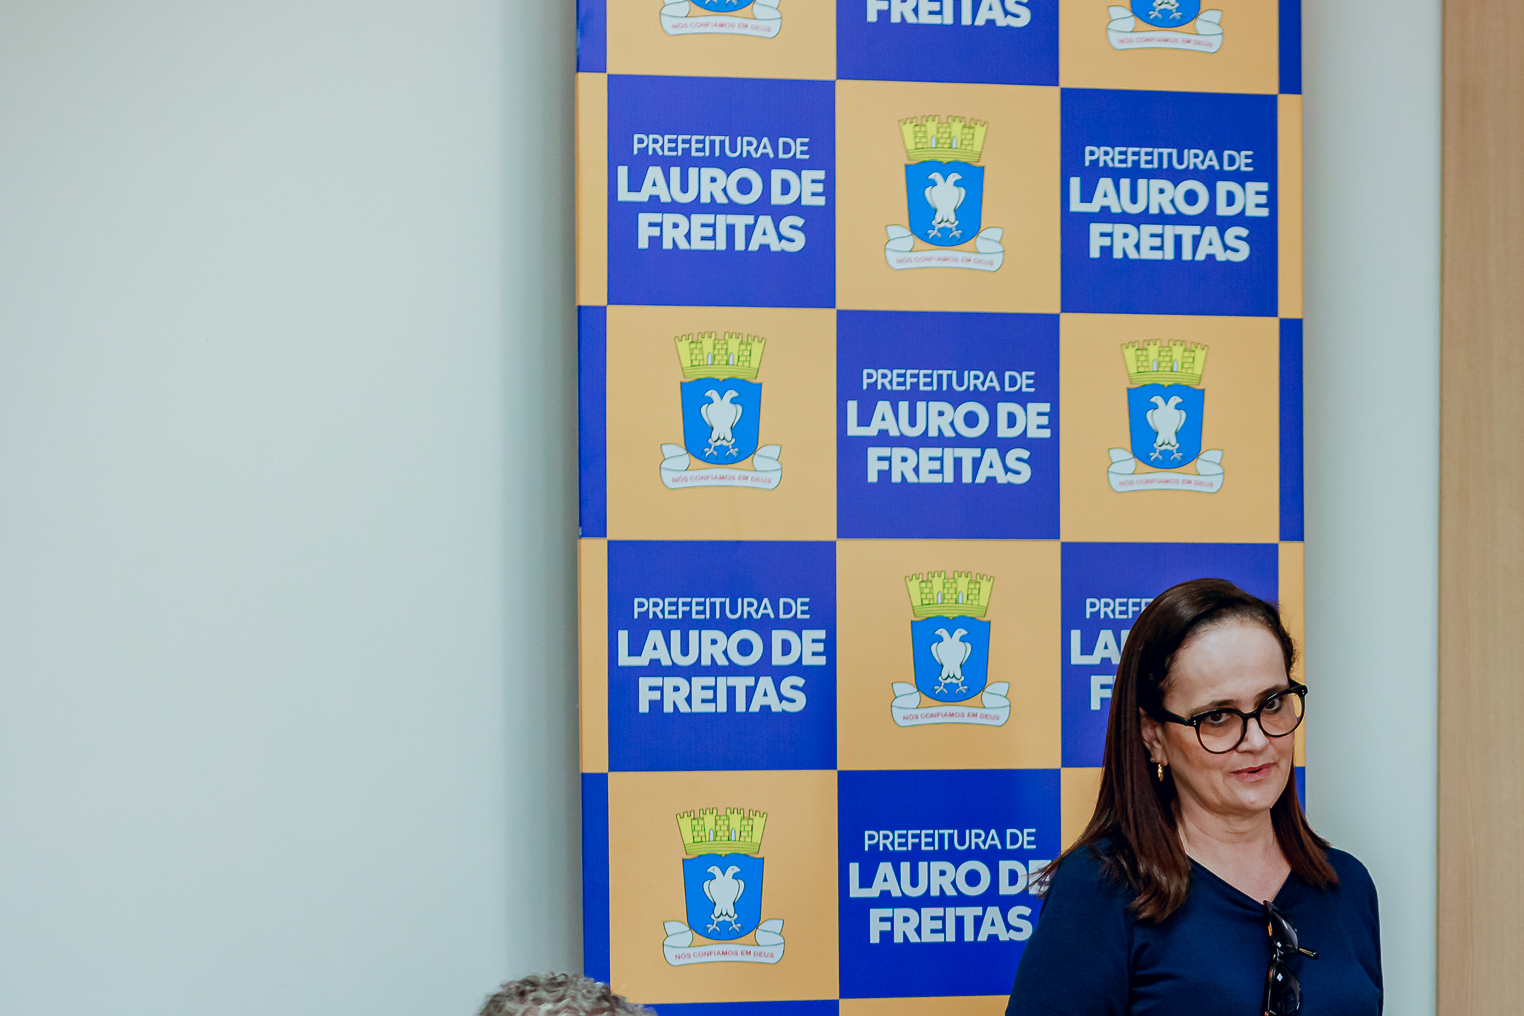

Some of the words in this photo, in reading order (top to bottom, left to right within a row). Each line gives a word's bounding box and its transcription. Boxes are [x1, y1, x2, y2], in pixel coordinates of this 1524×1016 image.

[867, 0, 1031, 27] FREITAS
[634, 134, 774, 158] PREFEITURA
[779, 138, 809, 159] DE
[1085, 146, 1219, 169] PREFEITURA
[1224, 151, 1253, 171] DE
[618, 166, 762, 204] LAURO
[771, 169, 825, 205] DE
[1070, 177, 1209, 215] LAURO
[1216, 181, 1269, 216] DE
[638, 213, 805, 252] FREITAS
[1090, 223, 1249, 261] FREITAS
[863, 369, 1000, 391] PREFEITURA
[1005, 371, 1035, 392] DE
[847, 400, 989, 437] LAURO
[997, 403, 1050, 437] DE
[750, 476, 772, 484] DEUS
[868, 447, 1031, 484] FREITAS
[634, 598, 774, 619] PREFEITURA
[780, 598, 810, 618] DE
[618, 630, 763, 666] LAURO
[772, 630, 826, 665] DE
[639, 676, 806, 712] FREITAS
[979, 713, 1000, 721] DEUS
[865, 830, 1001, 851] PREFEITURA
[1007, 829, 1036, 849] DE
[850, 861, 990, 897] LAURO
[999, 860, 1051, 894] DE
[870, 906, 1032, 943] FREITAS
[692, 950, 738, 958] CONFIAMOS
[753, 951, 774, 959] DEUS
